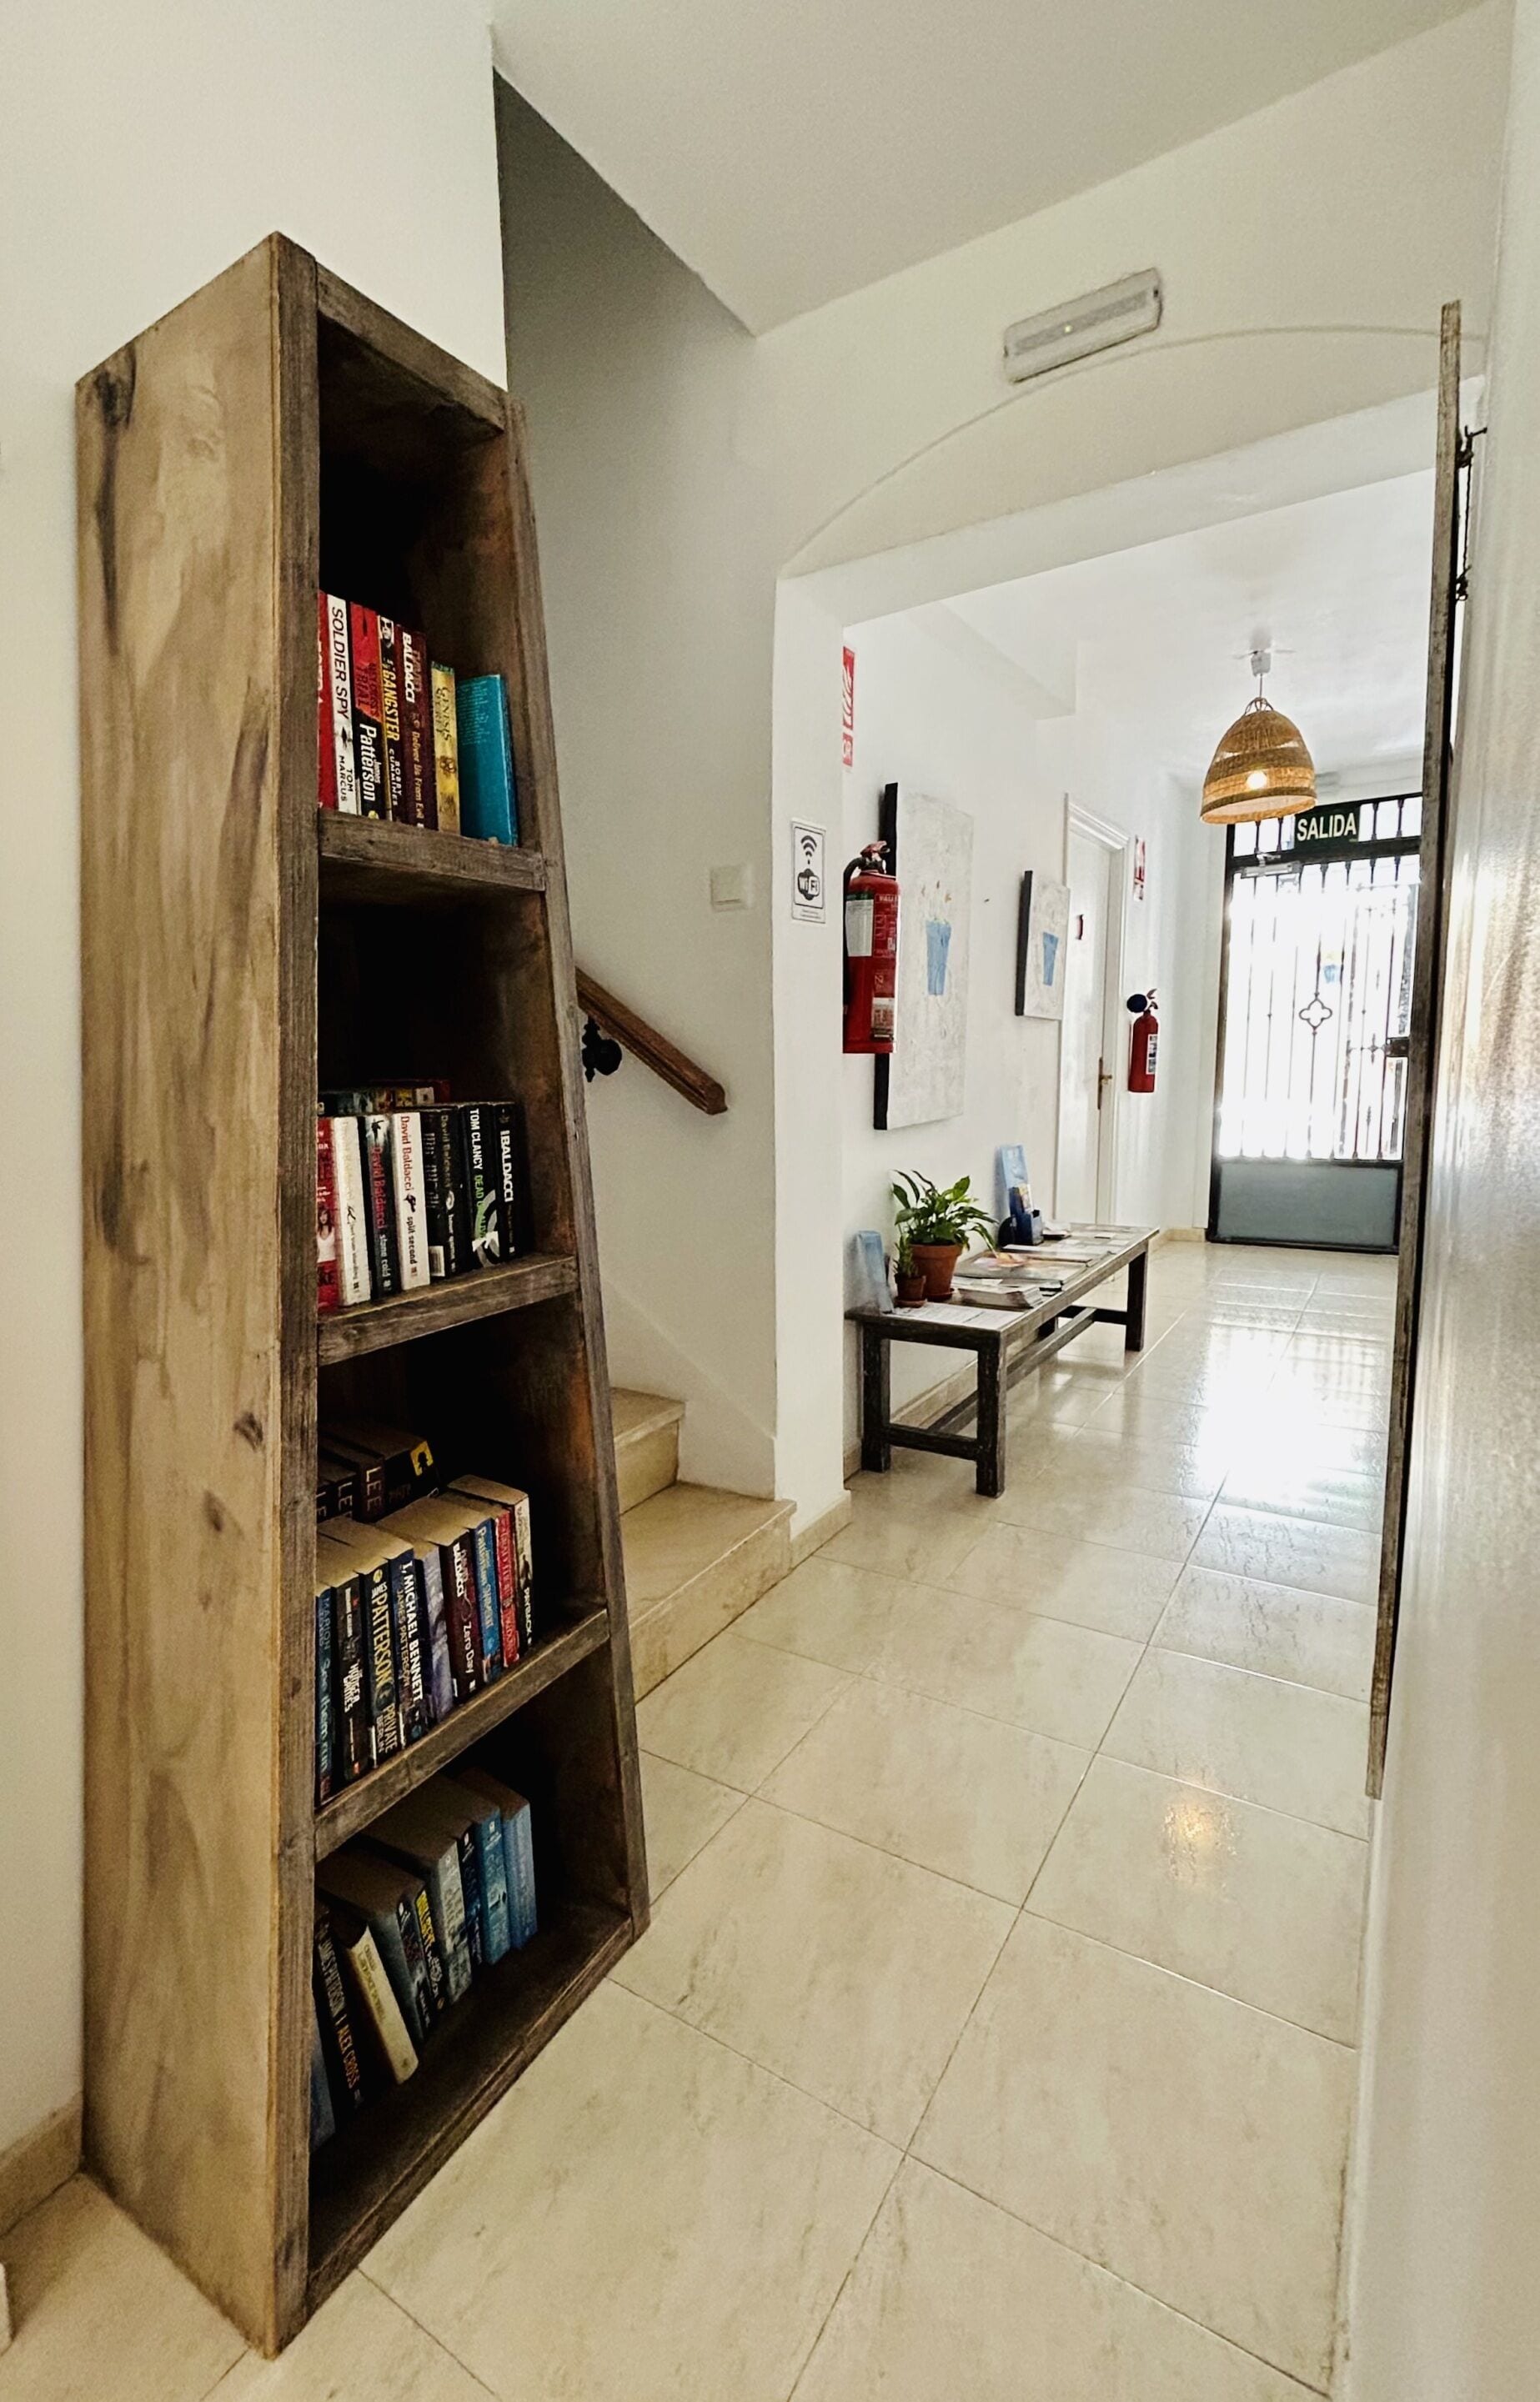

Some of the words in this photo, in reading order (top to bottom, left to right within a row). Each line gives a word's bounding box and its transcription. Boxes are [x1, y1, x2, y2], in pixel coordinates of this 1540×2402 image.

[332, 606, 347, 682] SOLDIER
[402, 631, 415, 704] BALDACCI
[335, 684, 349, 720] SPY
[382, 669, 400, 741] GANGSTER
[439, 686, 452, 741] GENESIS
[339, 755, 347, 801] MARCUS
[359, 723, 377, 801] Patterson
[414, 777, 423, 801] From
[1297, 812, 1357, 842] SALIDA
[401, 1116, 412, 1145] David
[441, 1114, 450, 1143] David
[469, 1108, 480, 1131] TOM
[371, 1145, 385, 1178] David
[402, 1147, 414, 1191] Baldacci
[444, 1143, 452, 1188] Baldacci
[471, 1131, 484, 1170] CLANCY
[500, 1135, 514, 1202] BALDACCI
[374, 1180, 387, 1229] Baldacci
[474, 1174, 484, 1199] DEAD
[406, 1216, 416, 1234] split
[379, 1234, 389, 1257] stone
[409, 1236, 419, 1265] second
[381, 1259, 392, 1277] cold
[366, 1467, 382, 1512] LEE
[400, 1560, 414, 1574] I,
[453, 1542, 464, 1598] BALDACCI
[477, 1525, 489, 1586] Patterson
[323, 1597, 331, 1650] MARION
[397, 1588, 407, 1624] JAMES
[404, 1574, 419, 1639] MICHAEL
[524, 1586, 533, 1636] PAYBACK
[372, 1592, 394, 1689] PATTERSON
[463, 1621, 472, 1650] Zero
[320, 1657, 331, 1692] See
[399, 1626, 411, 1687] PATTERSON
[409, 1638, 424, 1702] BENNETT
[465, 1649, 475, 1674] Day
[343, 1675, 354, 1713] GAMES
[348, 1662, 361, 1703] HUNGER
[321, 1694, 330, 1740] them
[376, 1714, 385, 1753] BERLIN
[382, 1702, 398, 1753] PRIVATE
[337, 2024, 353, 2055] ALEX
[343, 2050, 360, 2089] CROSS
